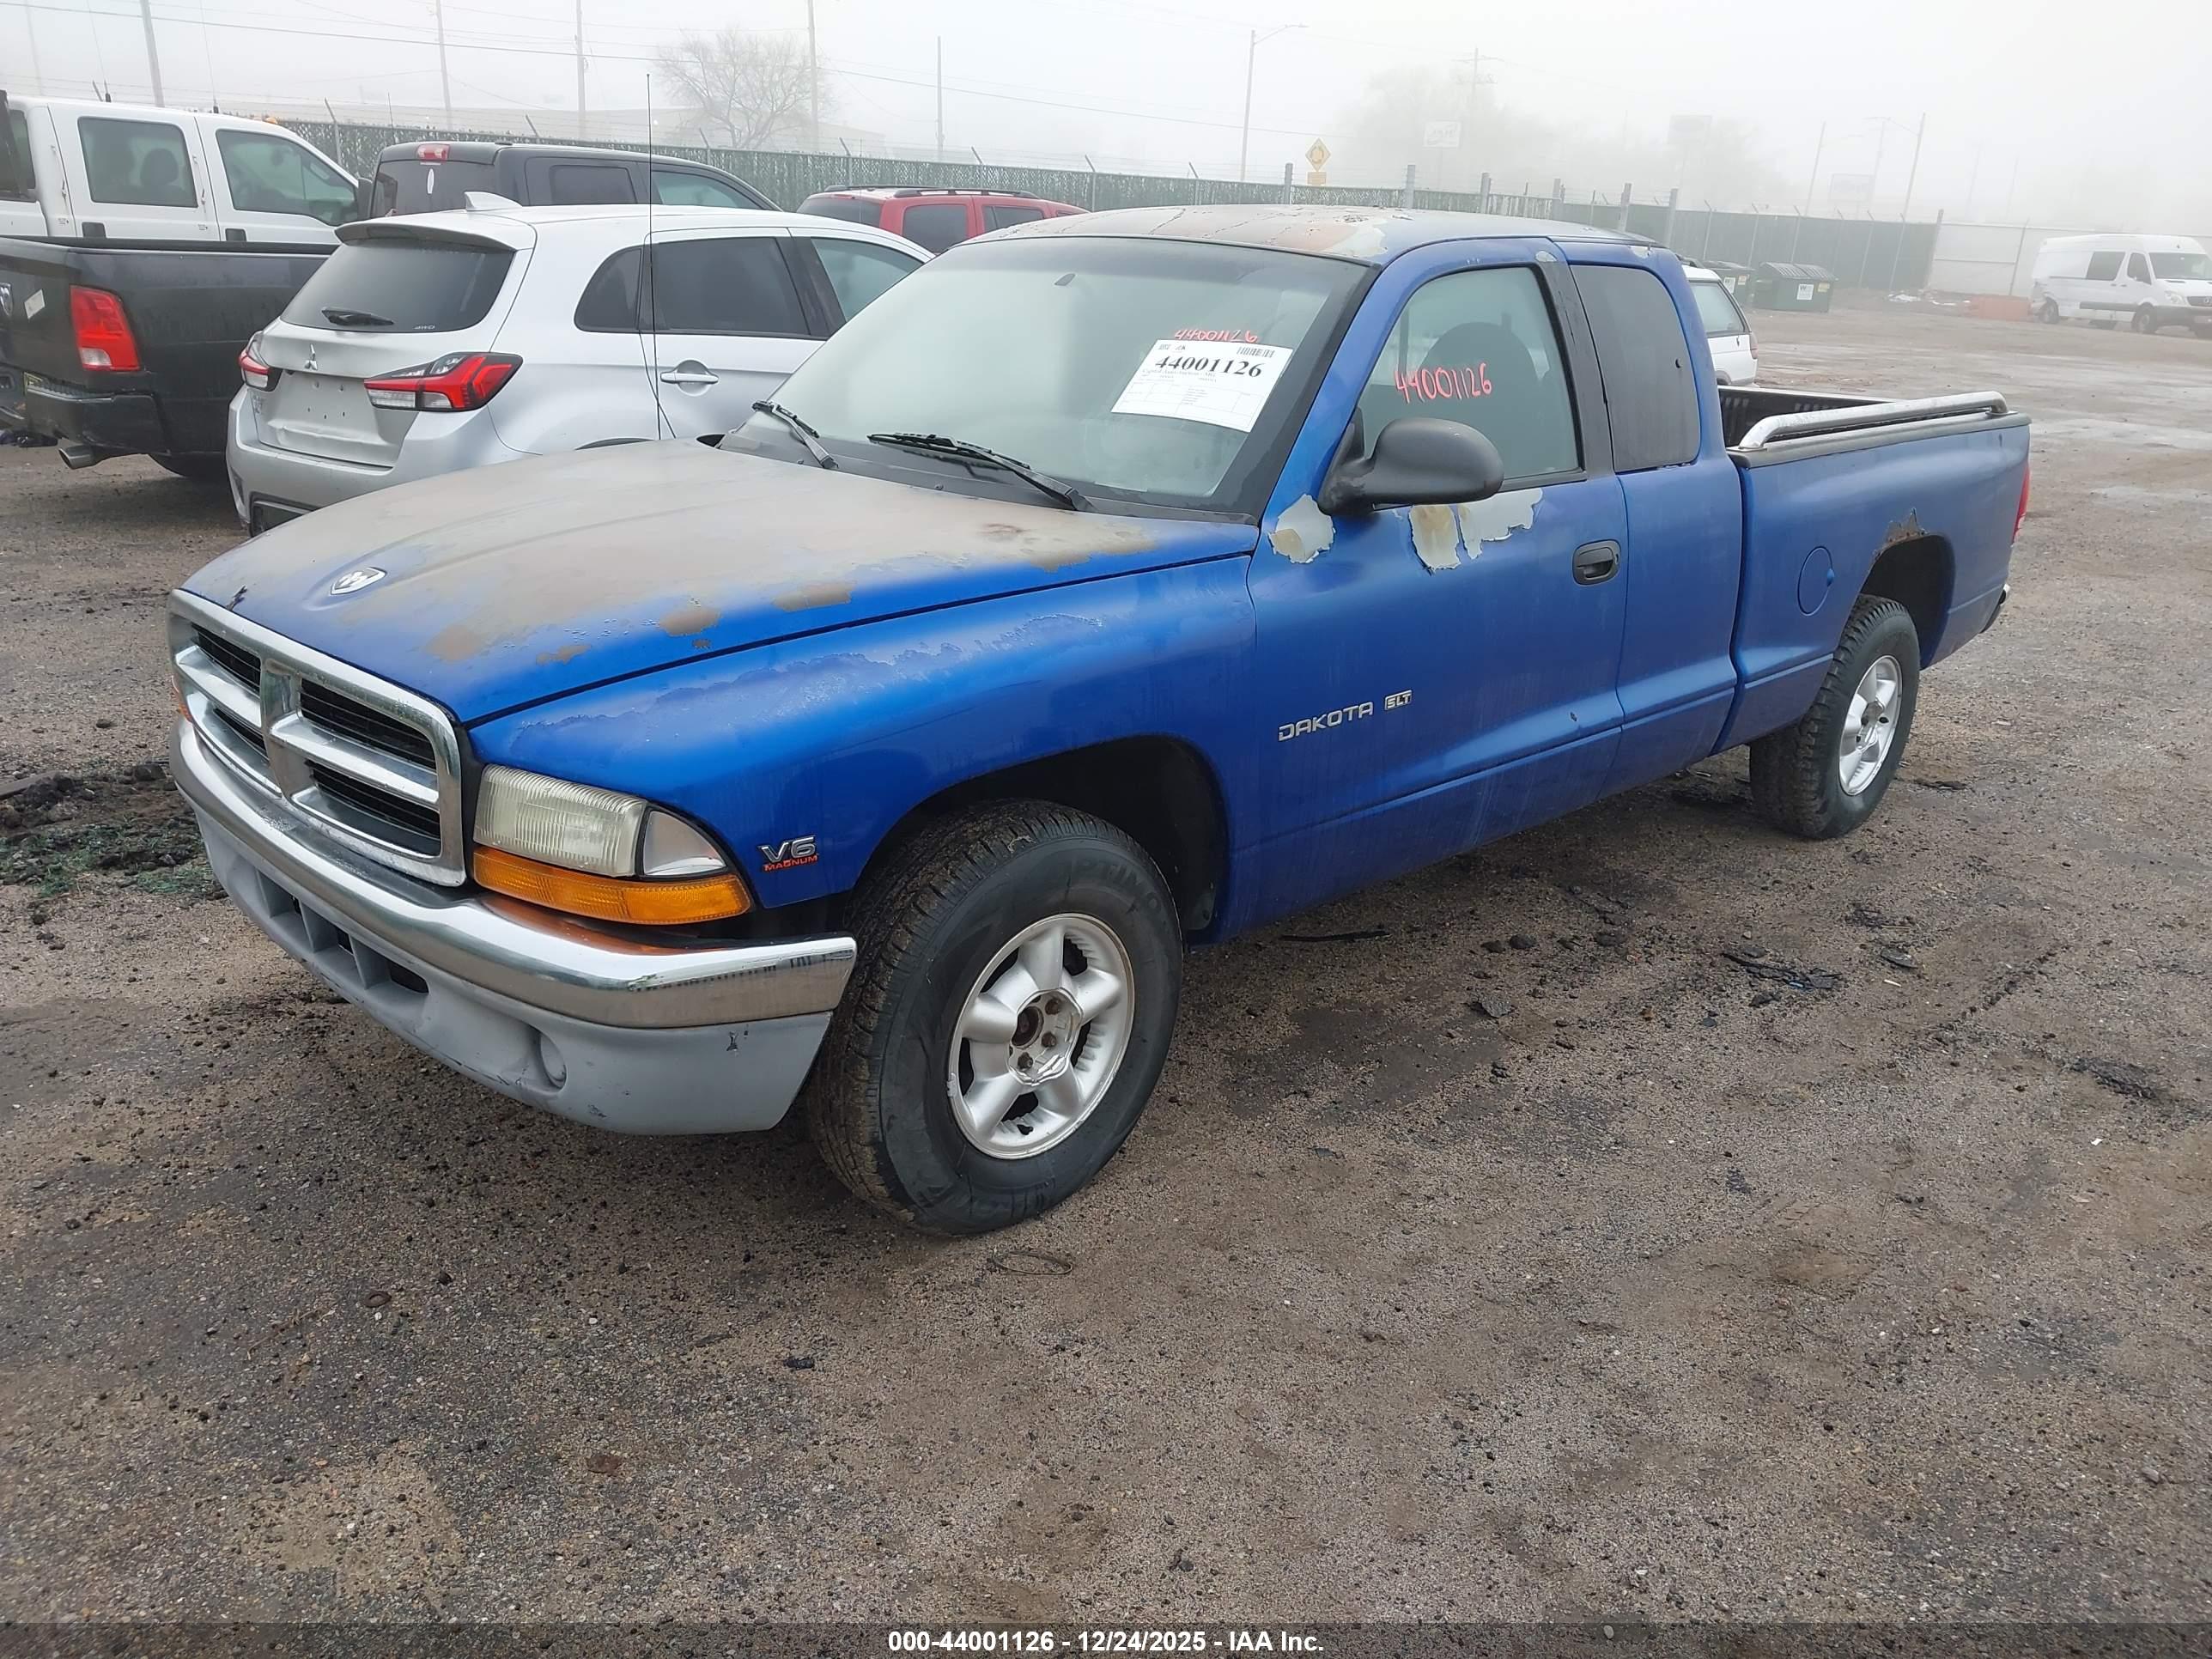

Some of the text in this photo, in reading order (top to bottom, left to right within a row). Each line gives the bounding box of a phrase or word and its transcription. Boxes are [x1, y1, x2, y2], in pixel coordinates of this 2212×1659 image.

[1175, 329, 1259, 343] 44001126
[1155, 356, 1266, 378] 44001126
[1395, 362, 1492, 404] 44001126
[1279, 690, 1413, 742] DAKOTA SLT
[759, 836, 815, 863] V6
[763, 854, 818, 872] MAGNUM
